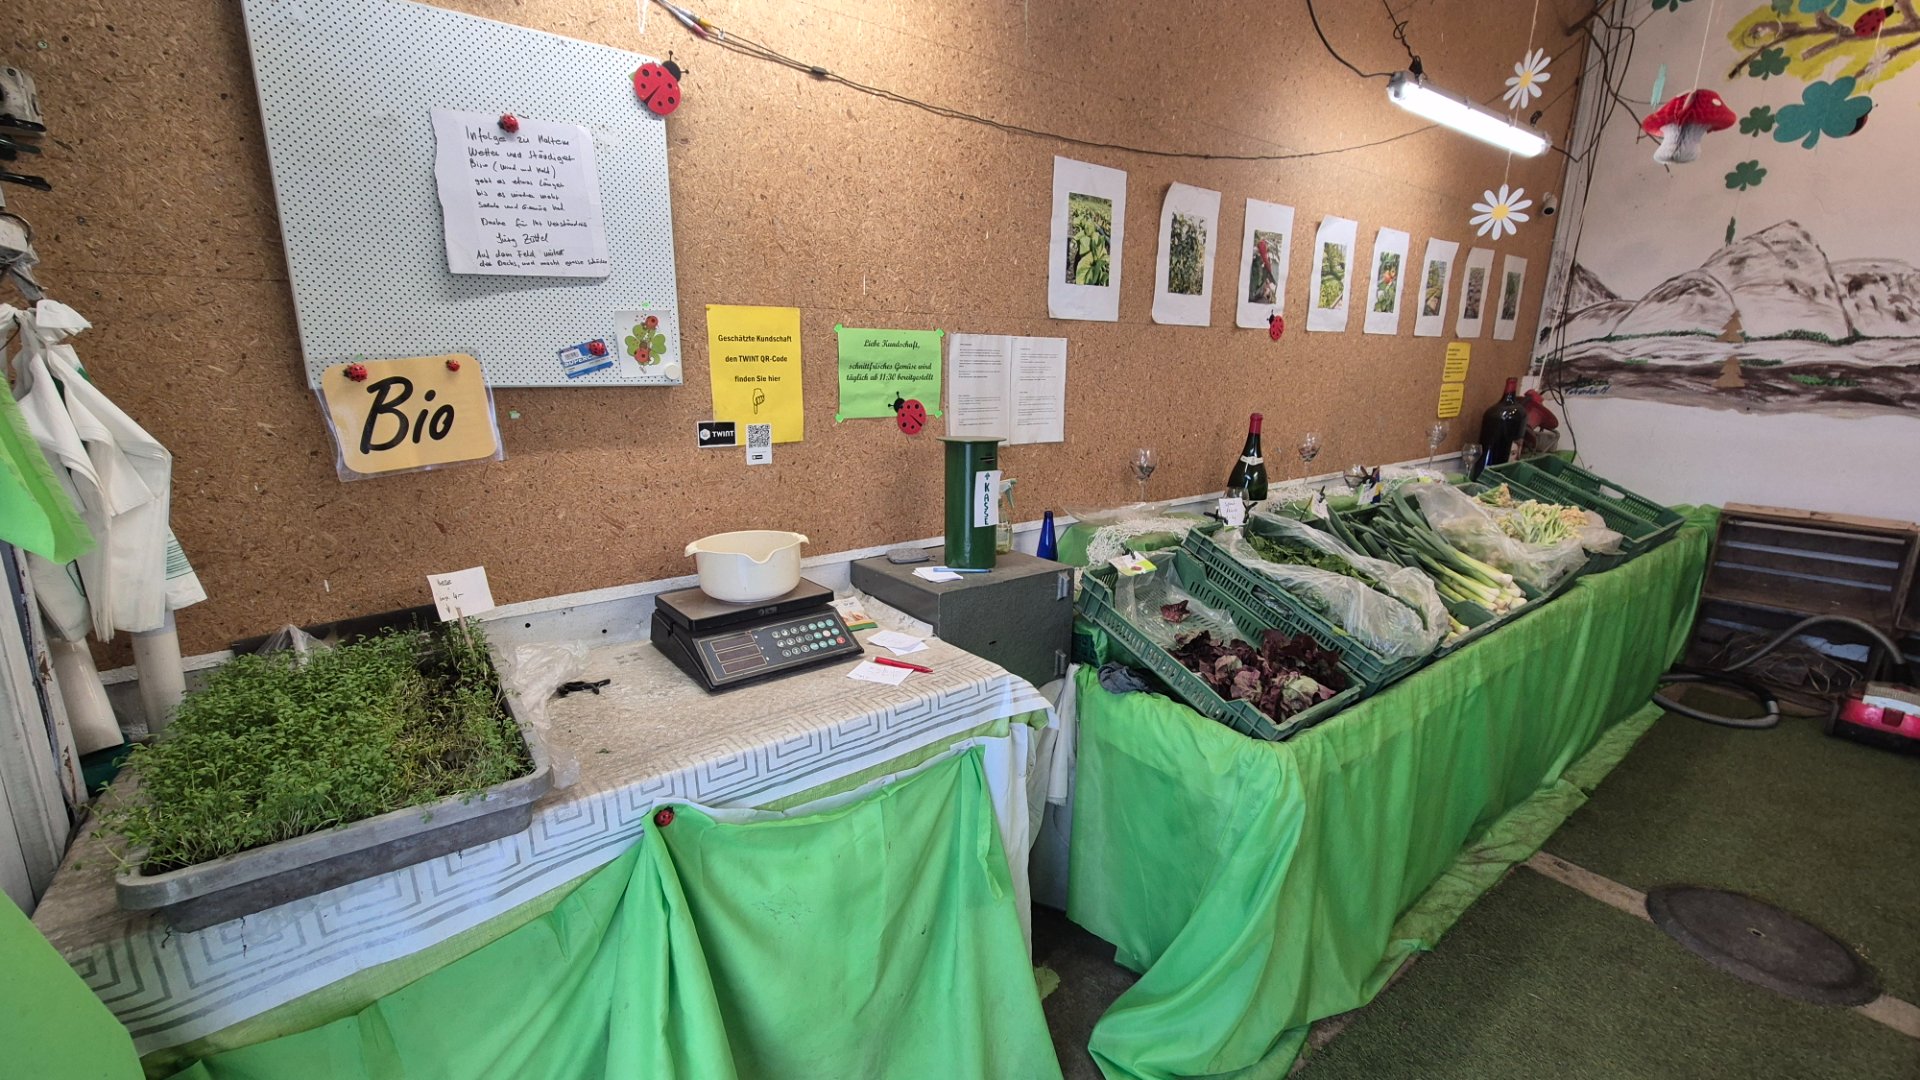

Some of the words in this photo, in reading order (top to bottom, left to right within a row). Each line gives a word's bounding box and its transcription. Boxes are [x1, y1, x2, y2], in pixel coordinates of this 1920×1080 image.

[465, 126, 507, 145] Infolge
[517, 135, 530, 144] zu
[467, 147, 500, 157] Wetter
[506, 151, 522, 159] und
[475, 188, 489, 197] bis
[480, 217, 507, 227] Danke
[515, 218, 528, 228] für
[476, 249, 490, 259] Auf
[495, 249, 513, 258] dem
[517, 249, 536, 258] Feld
[717, 334, 756, 343] Geschätzte
[756, 335, 792, 343] Kundschaft
[863, 339, 881, 348] Liebe
[724, 354, 738, 363] den
[738, 355, 759, 363] TWINT
[760, 354, 788, 363] QR-Code
[894, 362, 917, 371] Gemüse
[918, 362, 932, 370] wird
[734, 374, 756, 383] finden
[756, 374, 767, 382] Sie
[768, 374, 781, 382] hier
[846, 373, 869, 383] täglich
[869, 373, 879, 381] ab
[879, 373, 897, 381] 11:30
[897, 373, 934, 382] bereitgestellt
[359, 375, 455, 454] Bio
[711, 430, 735, 438] TWINT
[983, 482, 991, 526] KASSE
